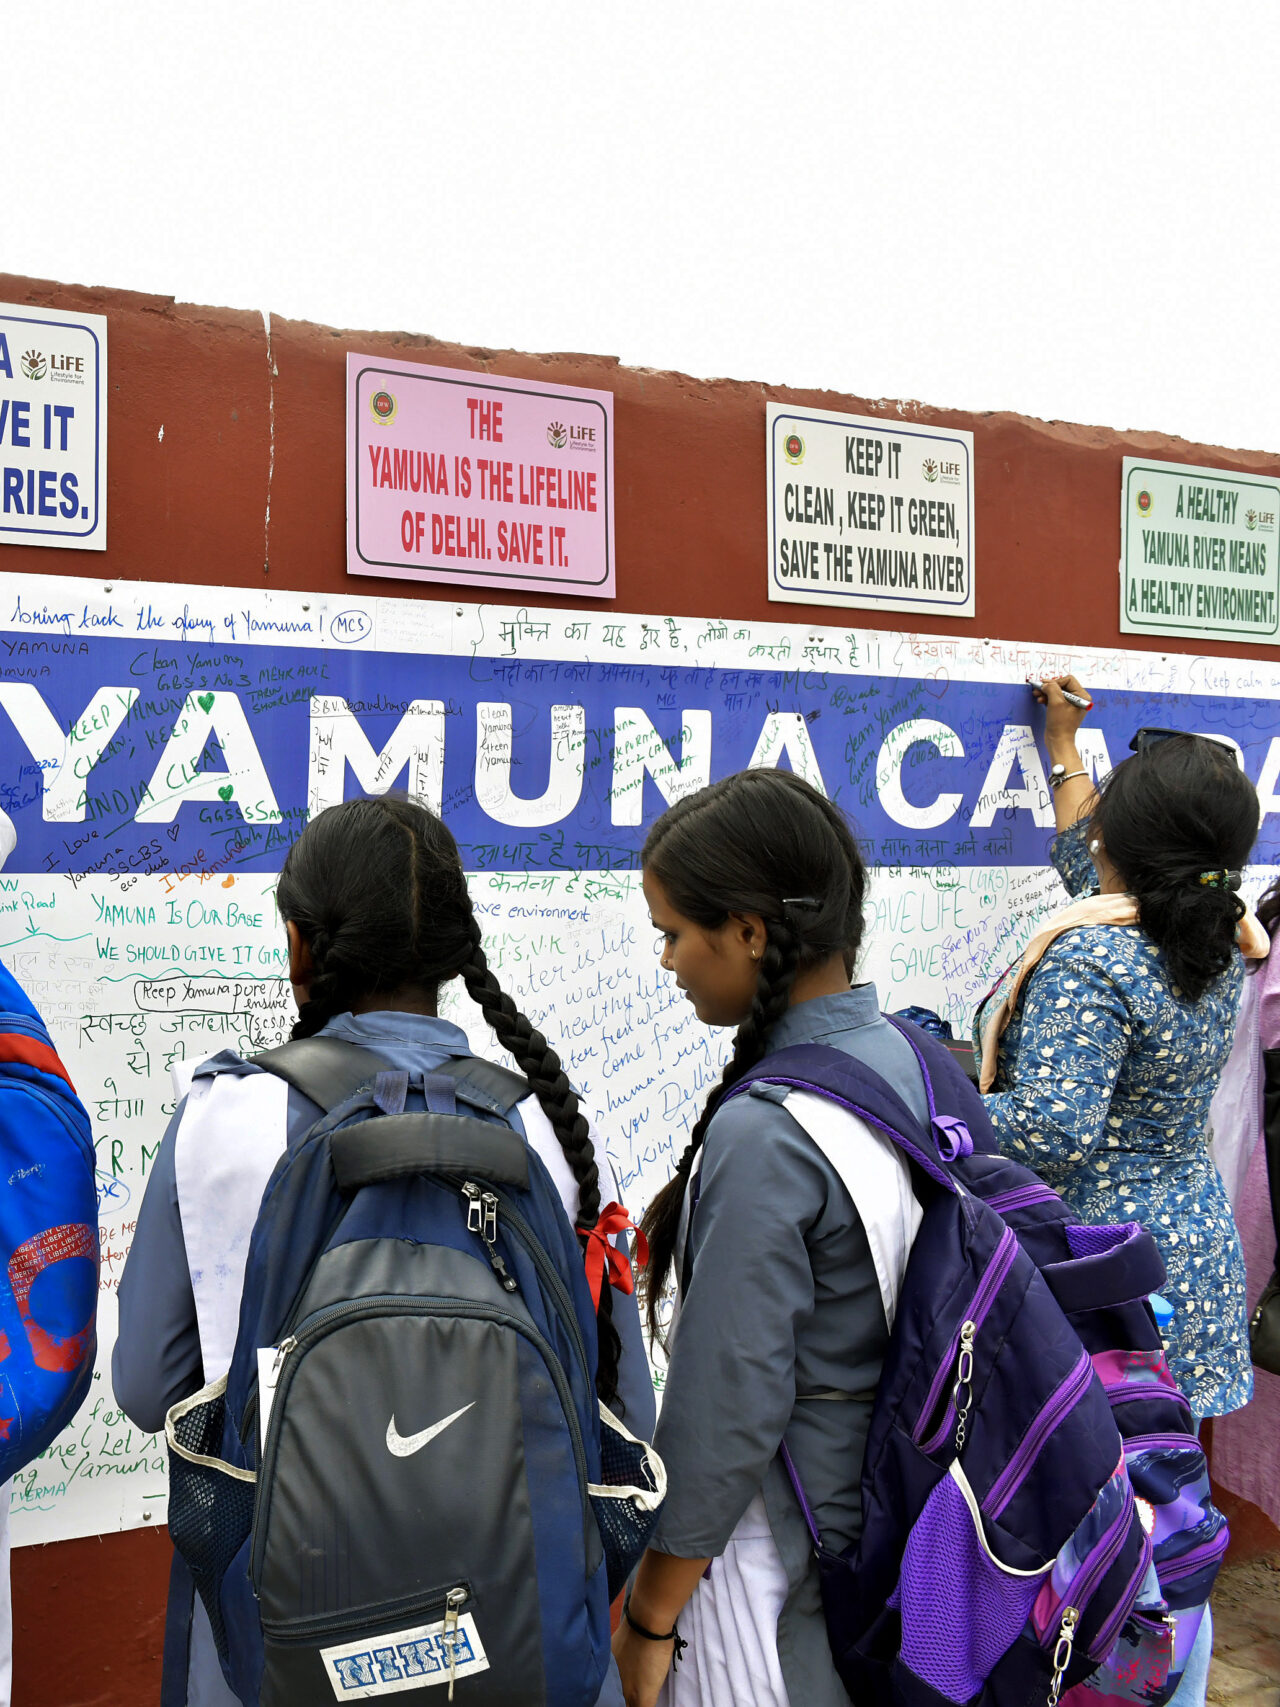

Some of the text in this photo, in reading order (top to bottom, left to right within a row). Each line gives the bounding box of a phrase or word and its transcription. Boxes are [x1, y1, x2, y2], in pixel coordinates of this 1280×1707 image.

[51, 354, 84, 372] LiFE
[43, 404, 74, 451] IT
[467, 398, 503, 442] THE
[570, 426, 596, 442] LiFE
[846, 436, 901, 479] KEEP IT
[368, 444, 596, 512] YAMUNA IS THE LIFELINE
[848, 491, 885, 531] KEEP
[890, 496, 904, 533] IT
[908, 498, 959, 548] GREEN,
[1175, 484, 1239, 525] A HEALTHY
[401, 510, 568, 568] OF DELHI. SAVE IT.
[1142, 530, 1266, 576] YAMUNA RIVER MEANS
[780, 538, 964, 593] SAVE THE YAMUNA RIVER
[1129, 578, 1275, 624] A HEALTHY ENVIRONMENT.
[135, 604, 165, 630] the
[224, 610, 236, 644] of
[336, 617, 365, 633] MCS
[565, 622, 591, 640] का
[602, 624, 626, 648] यह
[2, 639, 90, 657] YAMUNA
[69, 690, 197, 746] KEEP YAMUNA
[145, 719, 188, 750] KEEP
[43, 852, 60, 872] I
[107, 839, 163, 882] SSCBS
[120, 858, 169, 892] eco club
[159, 875, 175, 893] I
[91, 893, 156, 928] YAMUNA
[508, 904, 590, 922] environment
[96, 937, 252, 964] WE SHOULD GIVE IT
[143, 982, 175, 1007] Keep
[42, 1227, 71, 1245] LIBERTY
[61, 1457, 165, 1487] Yamuna
[333, 1628, 475, 1690] NIKE
